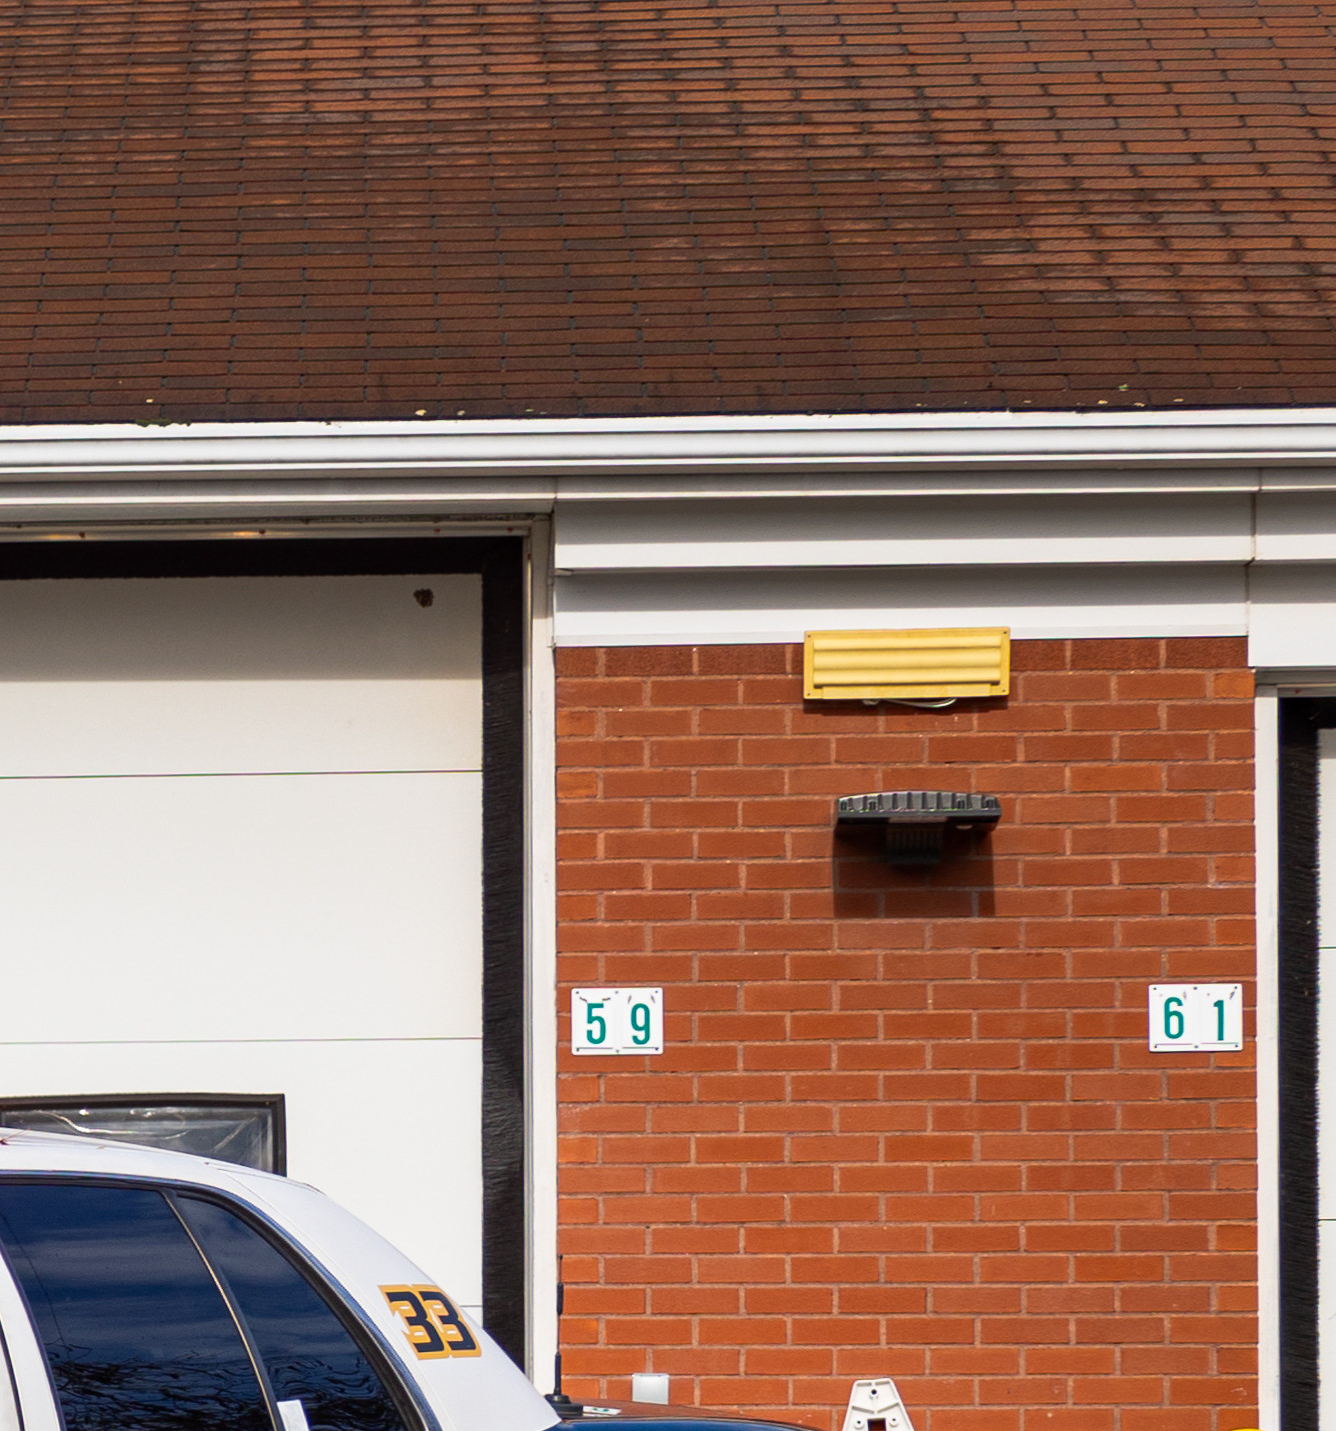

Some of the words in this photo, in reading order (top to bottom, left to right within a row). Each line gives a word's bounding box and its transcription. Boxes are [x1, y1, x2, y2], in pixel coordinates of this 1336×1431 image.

[586, 1002, 651, 1045] 59
[1164, 996, 1225, 1041] 61
[377, 1284, 482, 1360] 33
